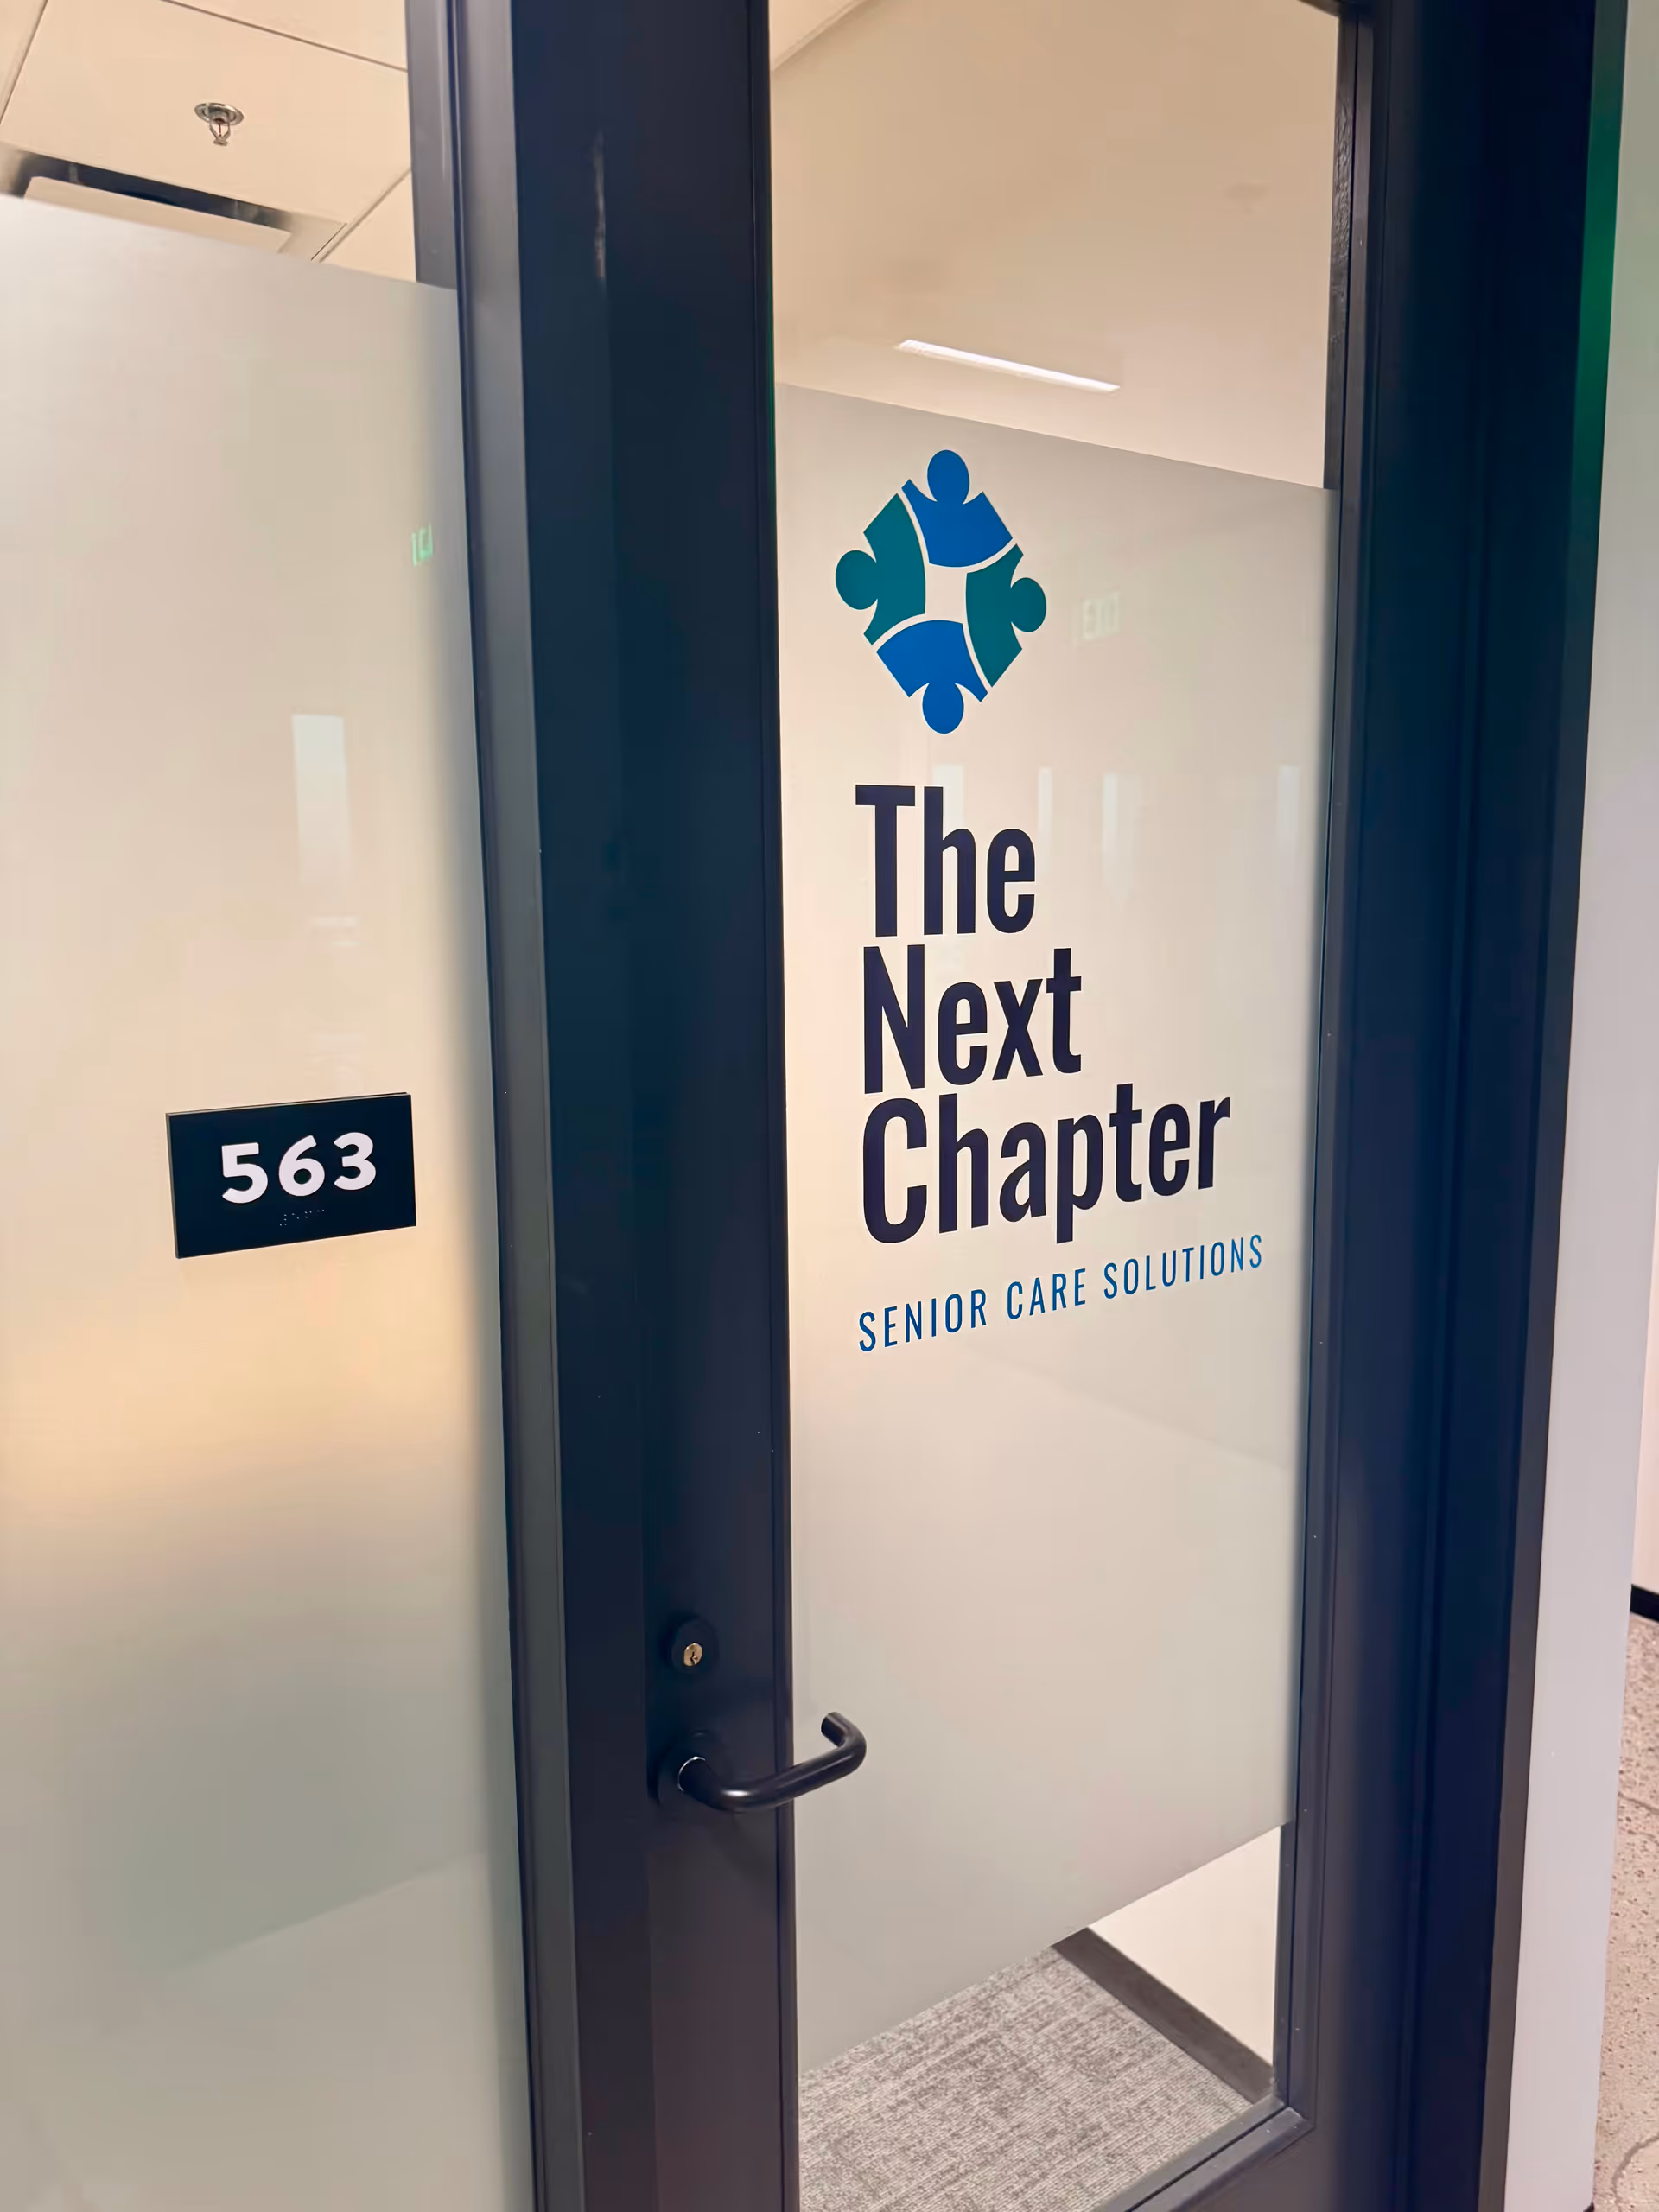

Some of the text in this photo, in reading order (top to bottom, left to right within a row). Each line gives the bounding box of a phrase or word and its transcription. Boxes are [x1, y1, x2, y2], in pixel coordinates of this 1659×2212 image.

[855, 784, 1036, 938] The
[863, 944, 1082, 1095] Next
[221, 1131, 377, 1204] 563
[862, 1083, 1231, 1245] Chapter
[858, 1233, 1262, 1353] SENIOR CARE SOLUTIONS
